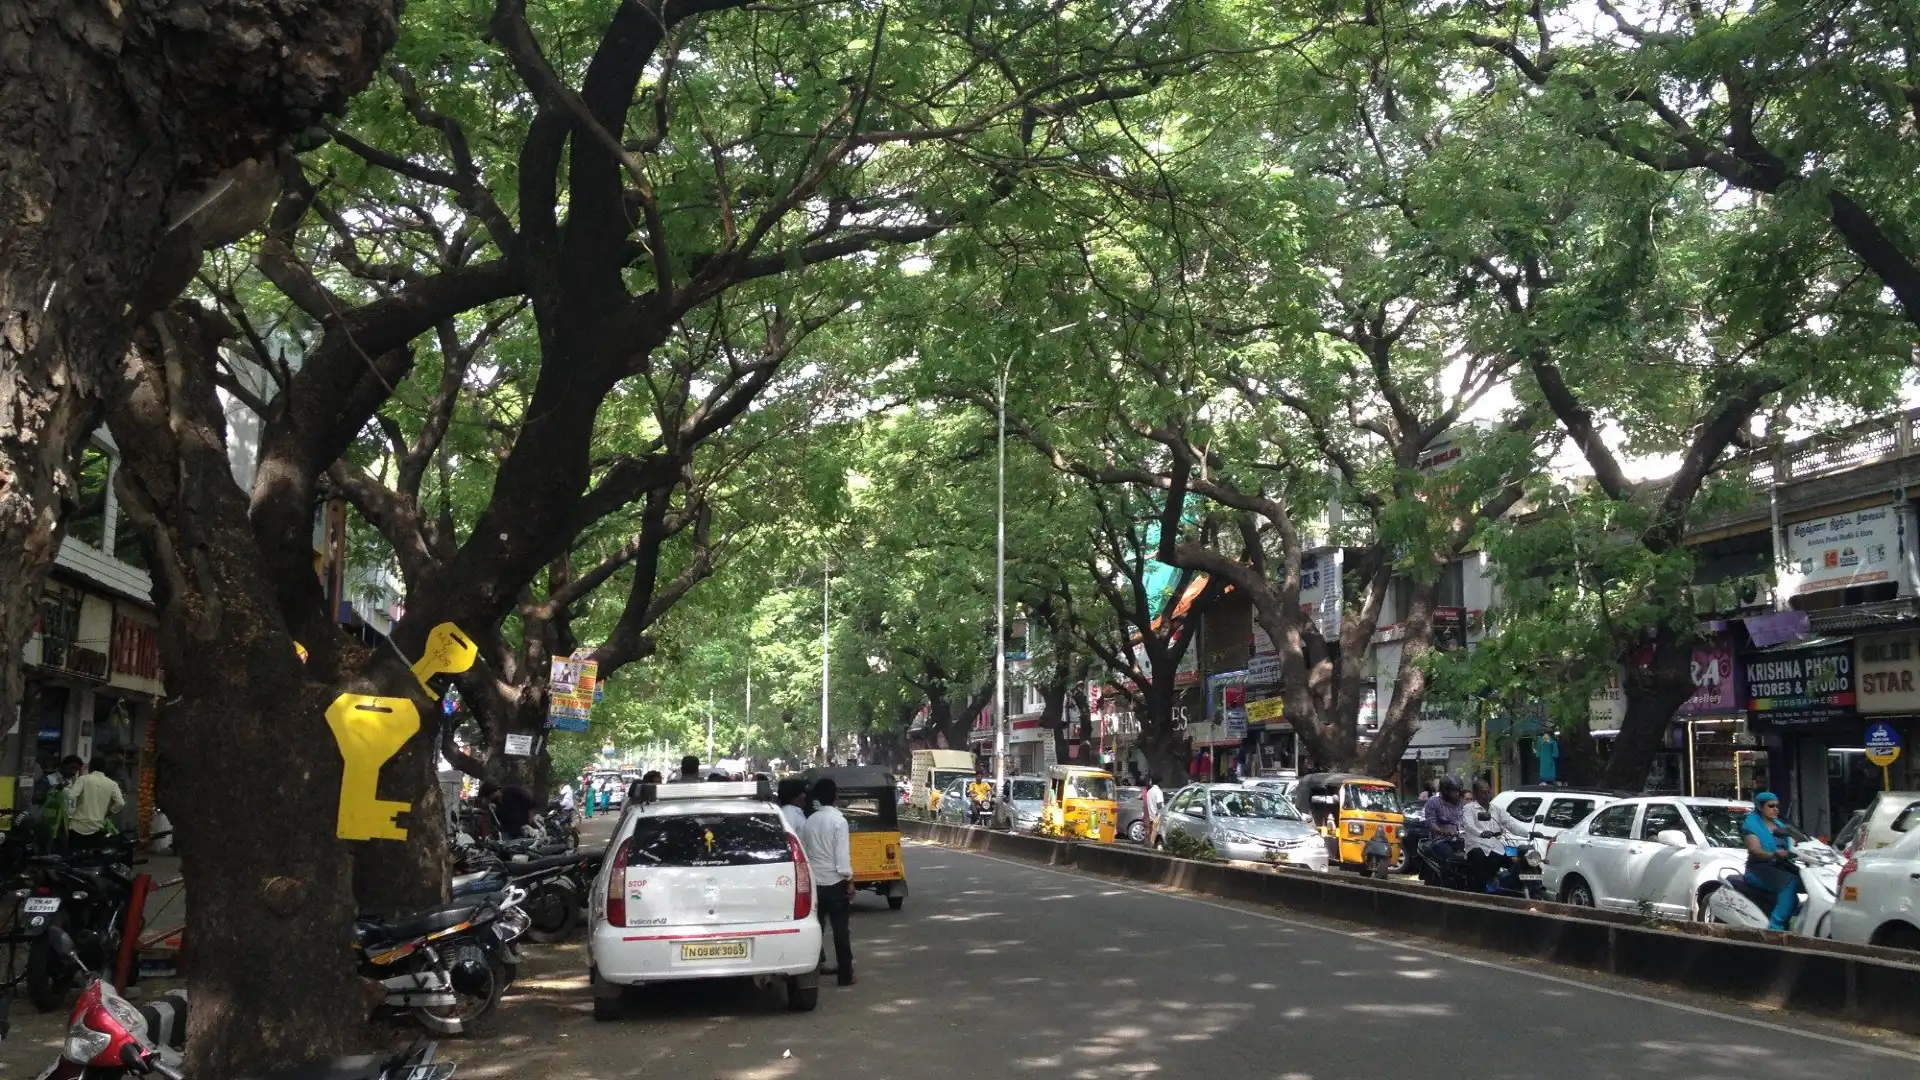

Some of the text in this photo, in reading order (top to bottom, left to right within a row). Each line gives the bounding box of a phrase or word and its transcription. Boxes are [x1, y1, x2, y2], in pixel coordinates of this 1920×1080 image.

[1746, 659, 1802, 682] KRISHNA
[1751, 681, 1792, 697] STORES
[1794, 681, 1803, 694] &
[1862, 670, 1915, 695] STAR
[628, 879, 647, 888] STOP
